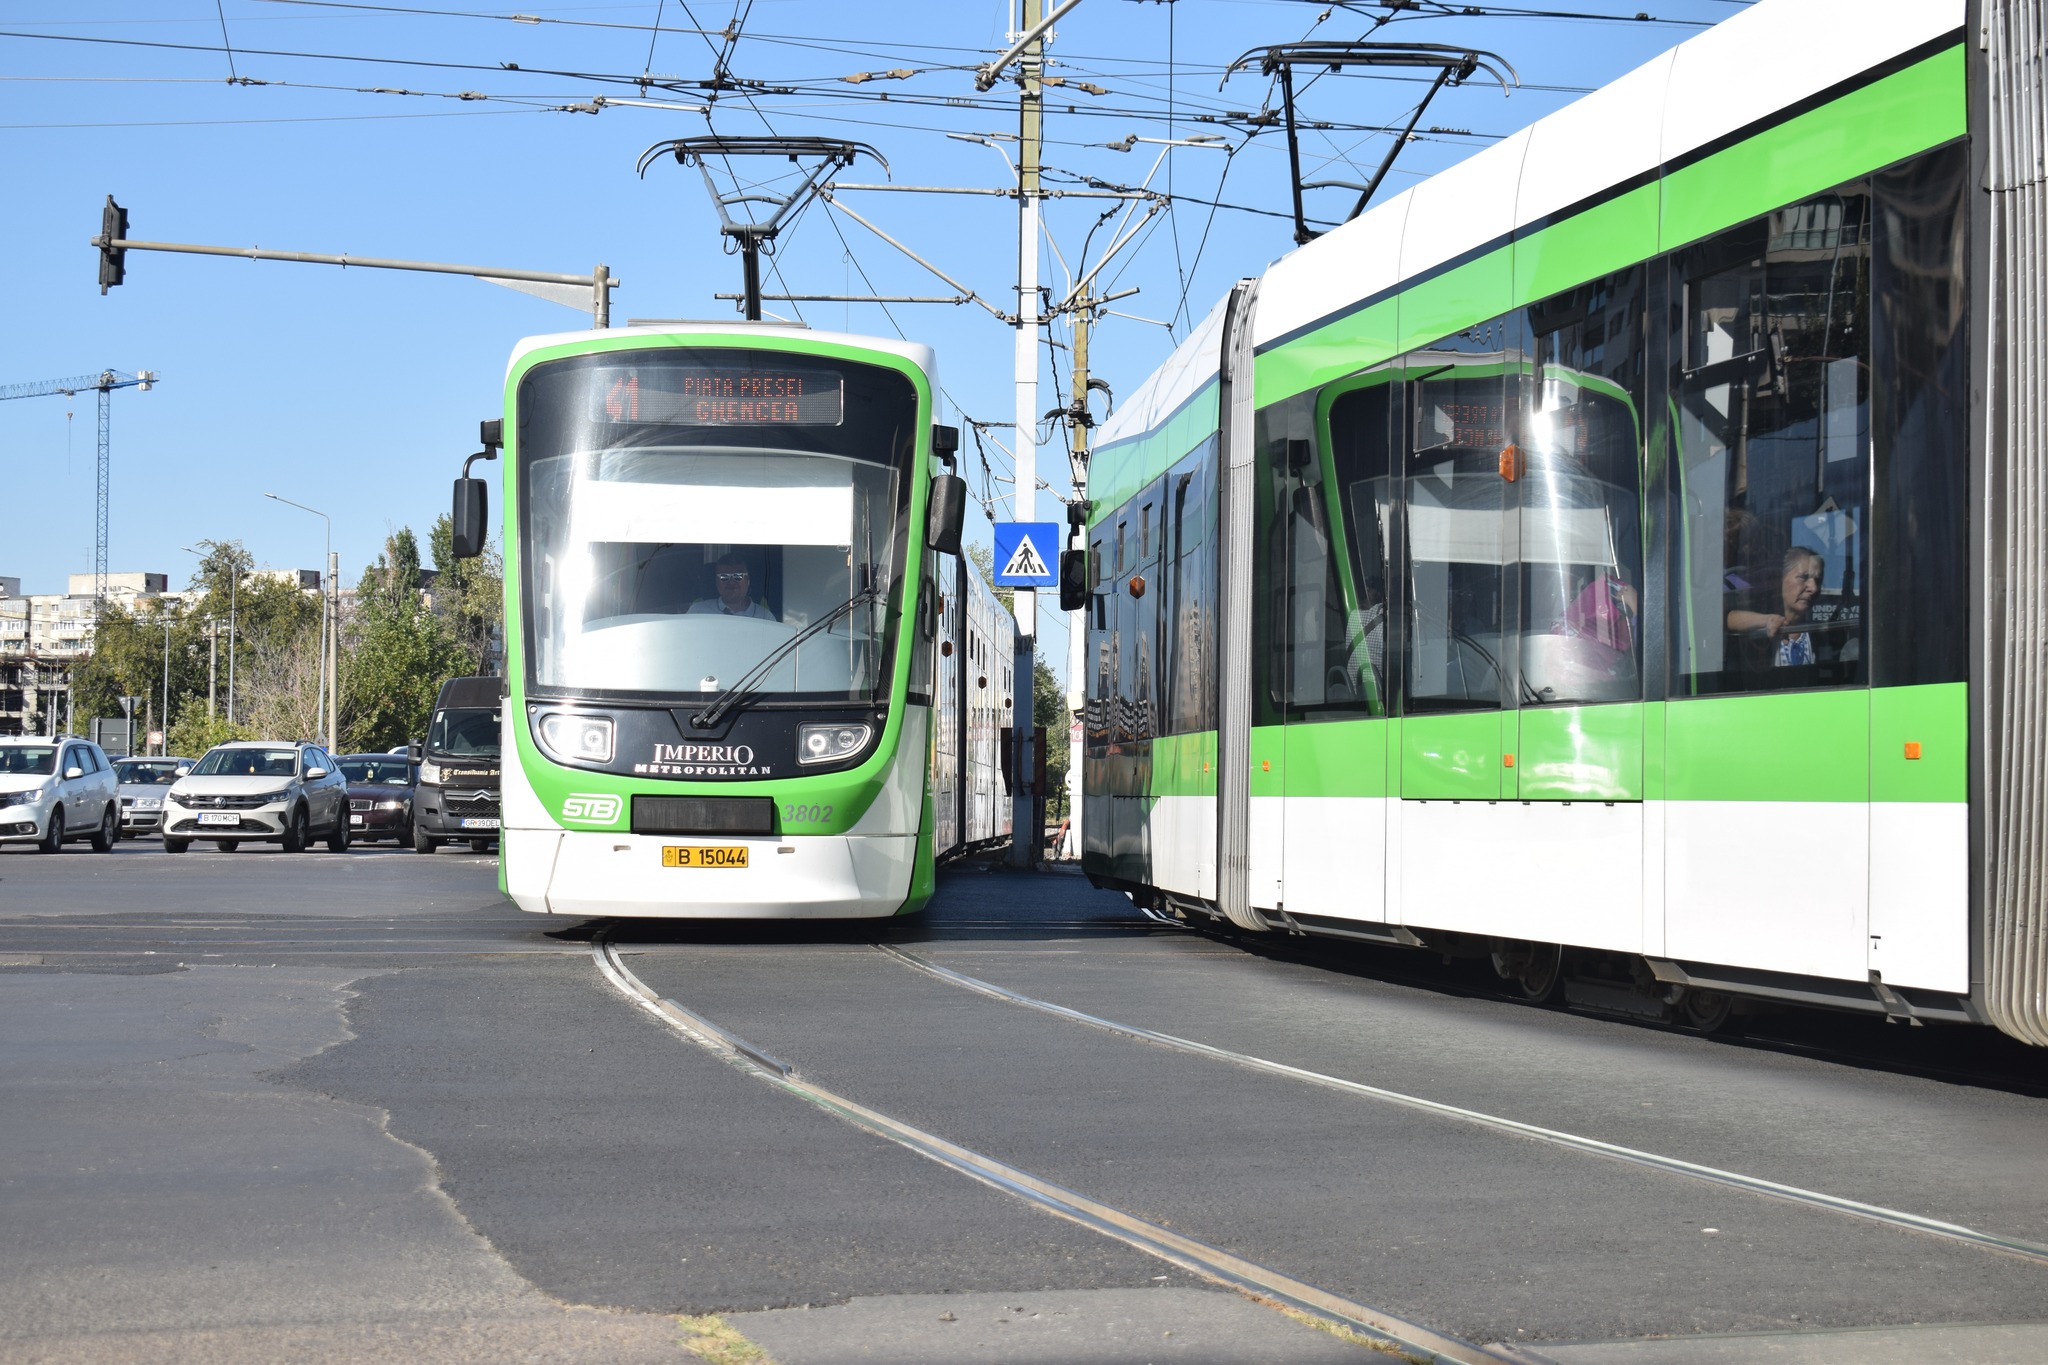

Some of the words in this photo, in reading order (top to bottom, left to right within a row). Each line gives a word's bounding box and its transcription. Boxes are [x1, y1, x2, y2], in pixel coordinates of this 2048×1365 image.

[685, 378, 733, 397] PIATA
[741, 378, 802, 397] PRESEI
[606, 377, 638, 421] 41
[696, 401, 799, 421] GHENCEA
[652, 743, 754, 765] IMPERIO
[634, 763, 771, 775] METROPOLITAN
[562, 798, 617, 818] STB
[782, 804, 834, 823] 3802
[679, 849, 690, 864] B
[699, 849, 746, 865] 15044
